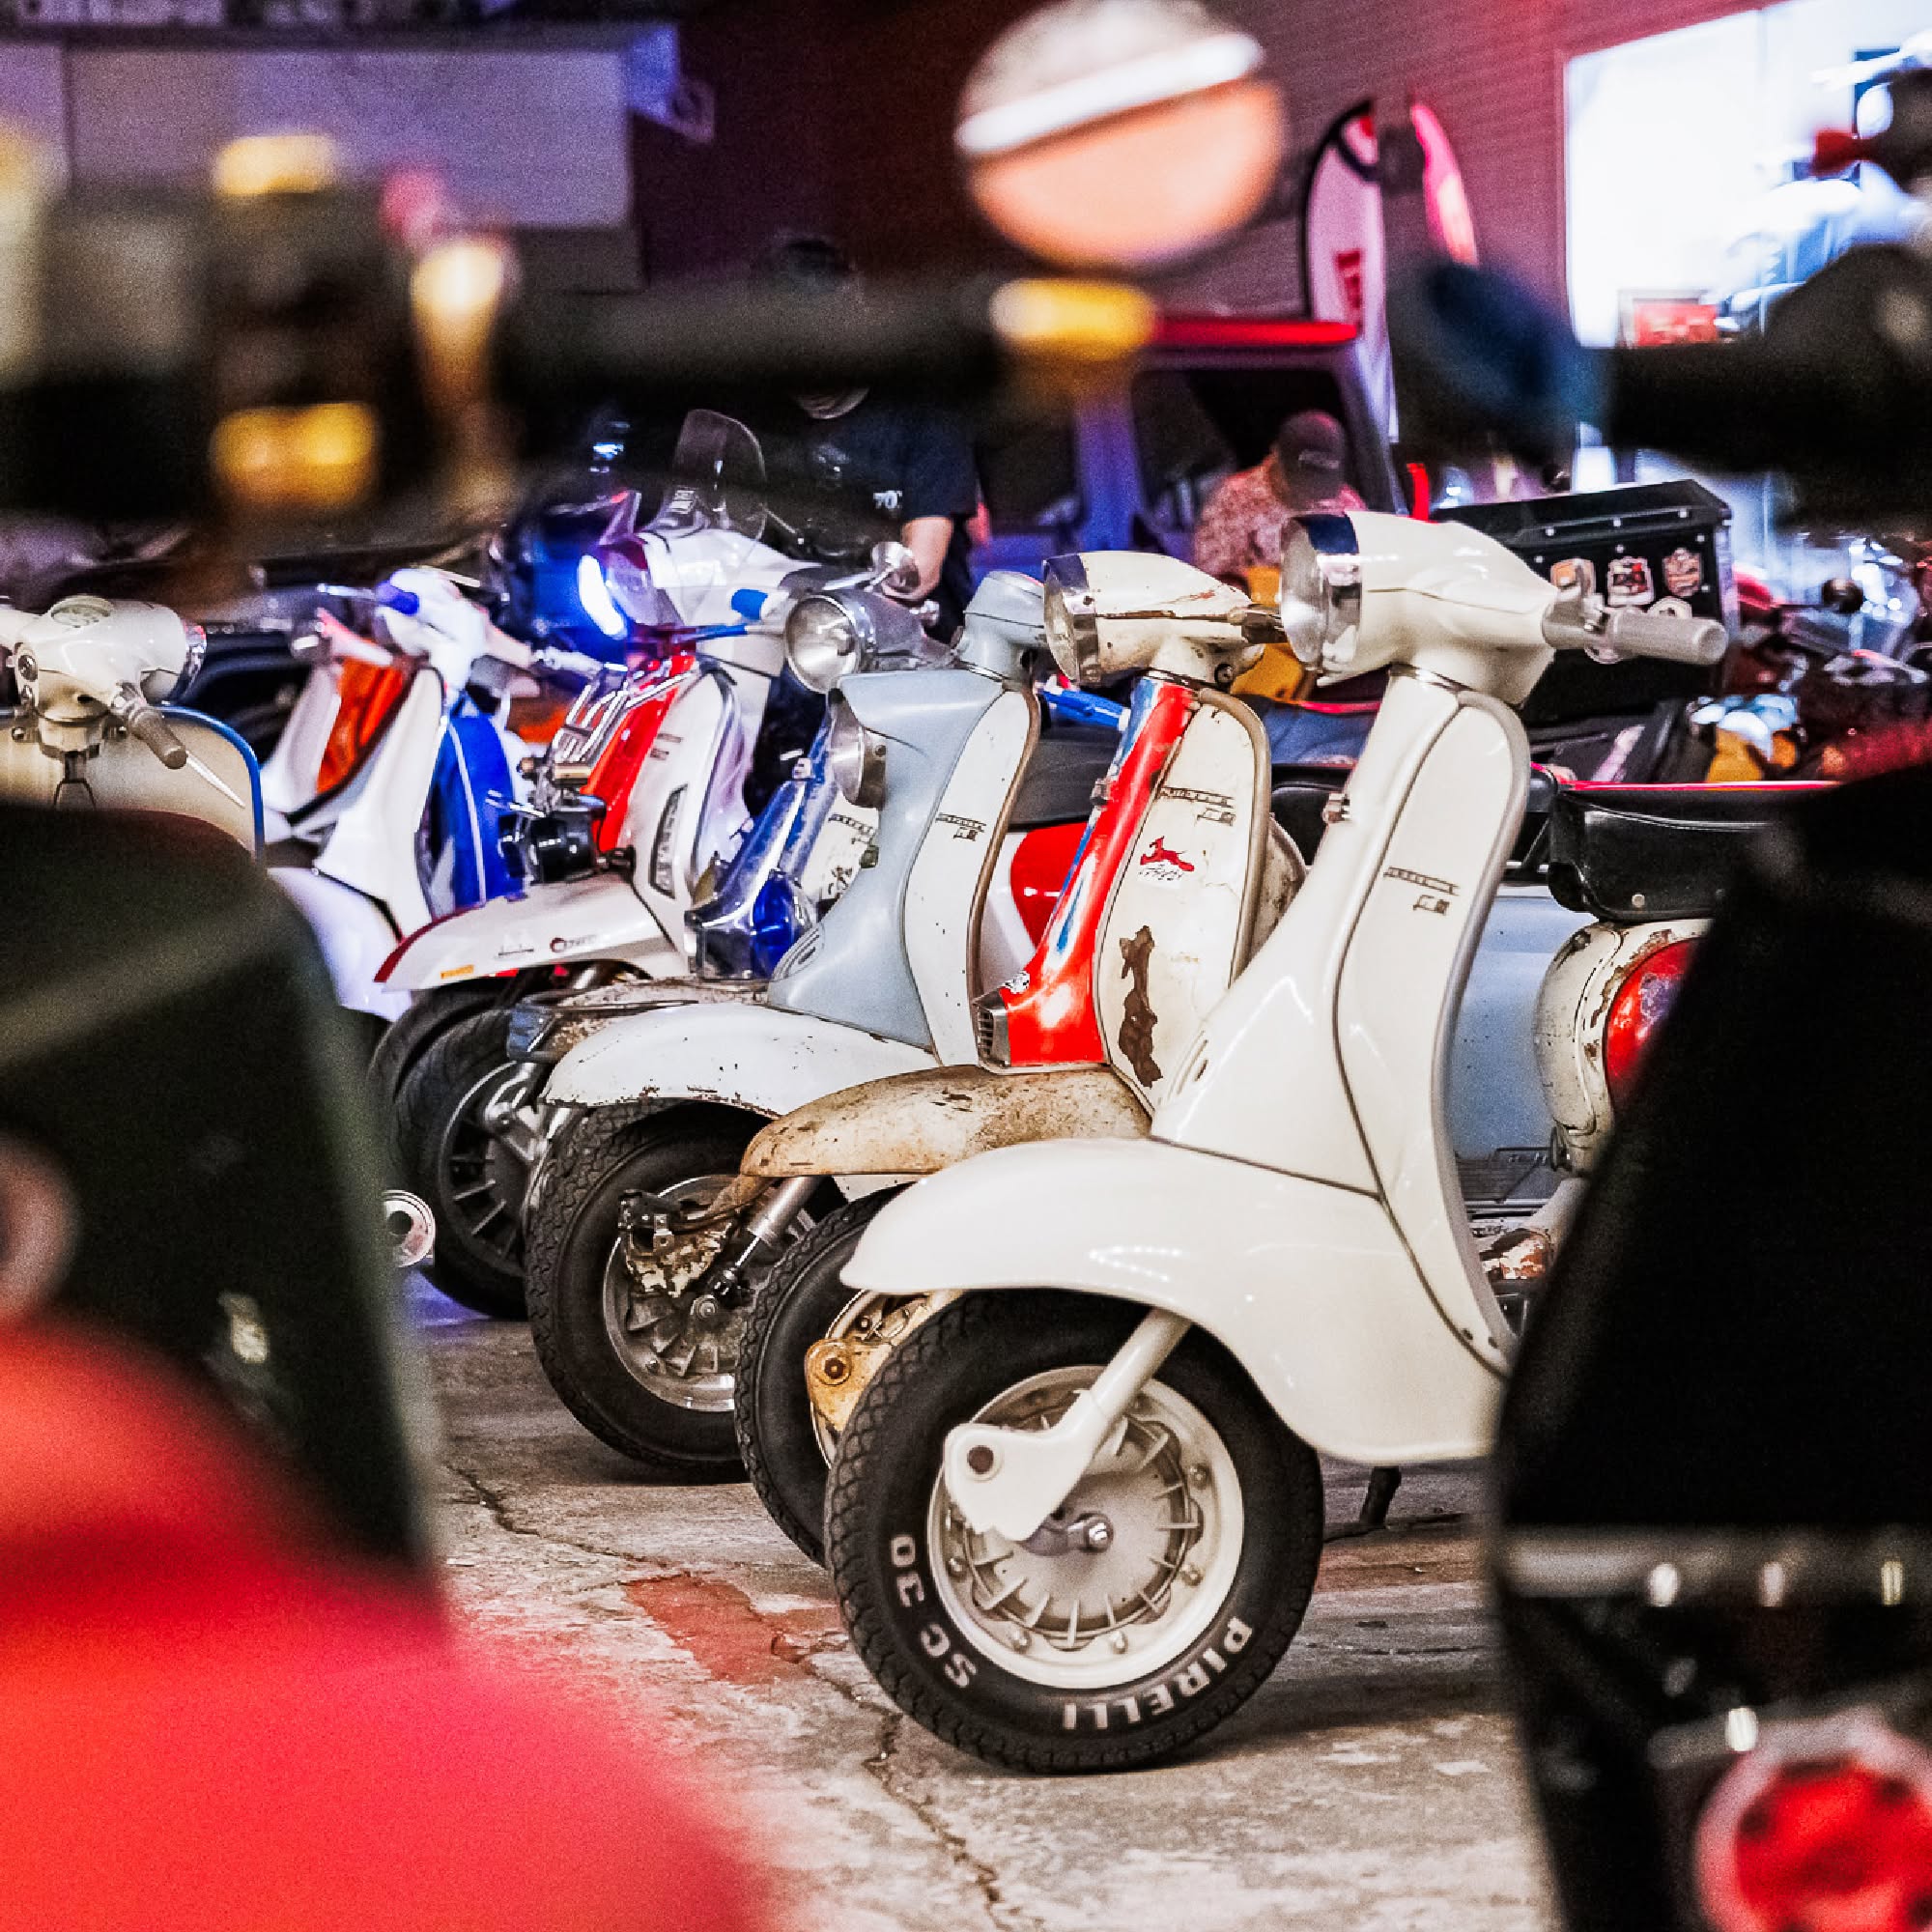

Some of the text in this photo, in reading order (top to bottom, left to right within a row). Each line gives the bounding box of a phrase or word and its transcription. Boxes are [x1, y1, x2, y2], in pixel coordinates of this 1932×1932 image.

[890, 1534, 979, 1689] SC 30
[1063, 1615, 1254, 1731] PIRELLI
